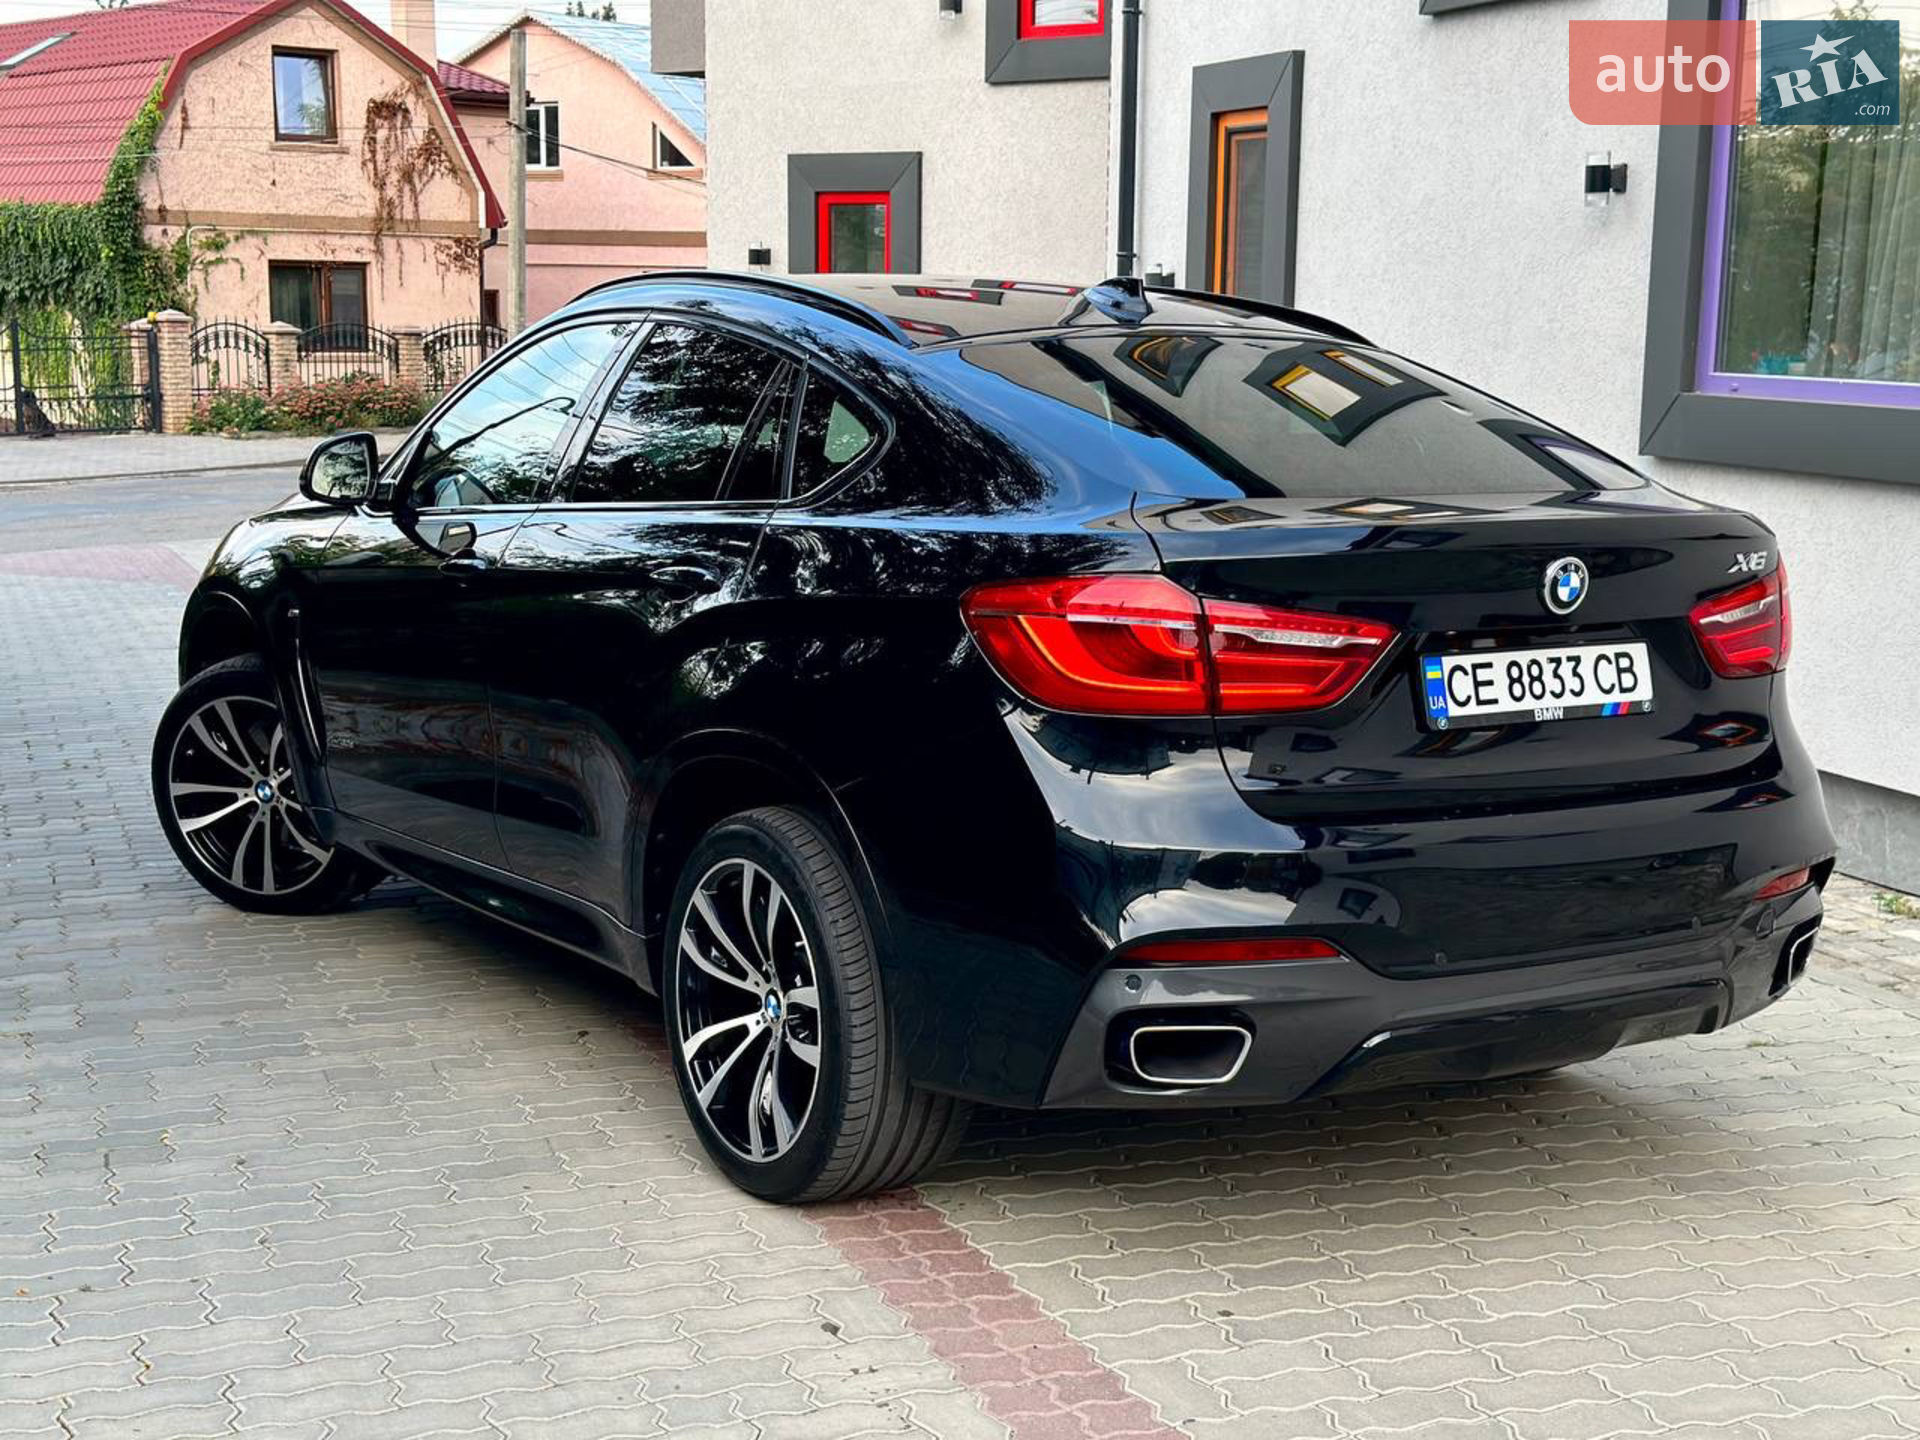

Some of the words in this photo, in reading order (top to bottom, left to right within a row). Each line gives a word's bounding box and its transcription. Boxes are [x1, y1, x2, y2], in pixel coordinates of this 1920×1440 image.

[1727, 551, 1767, 573] X6
[1448, 662, 1499, 707] CE
[1506, 655, 1585, 702] 8833
[1594, 651, 1638, 695] CB
[1430, 696, 1446, 710] UA
[1534, 707, 1564, 721] BMW
